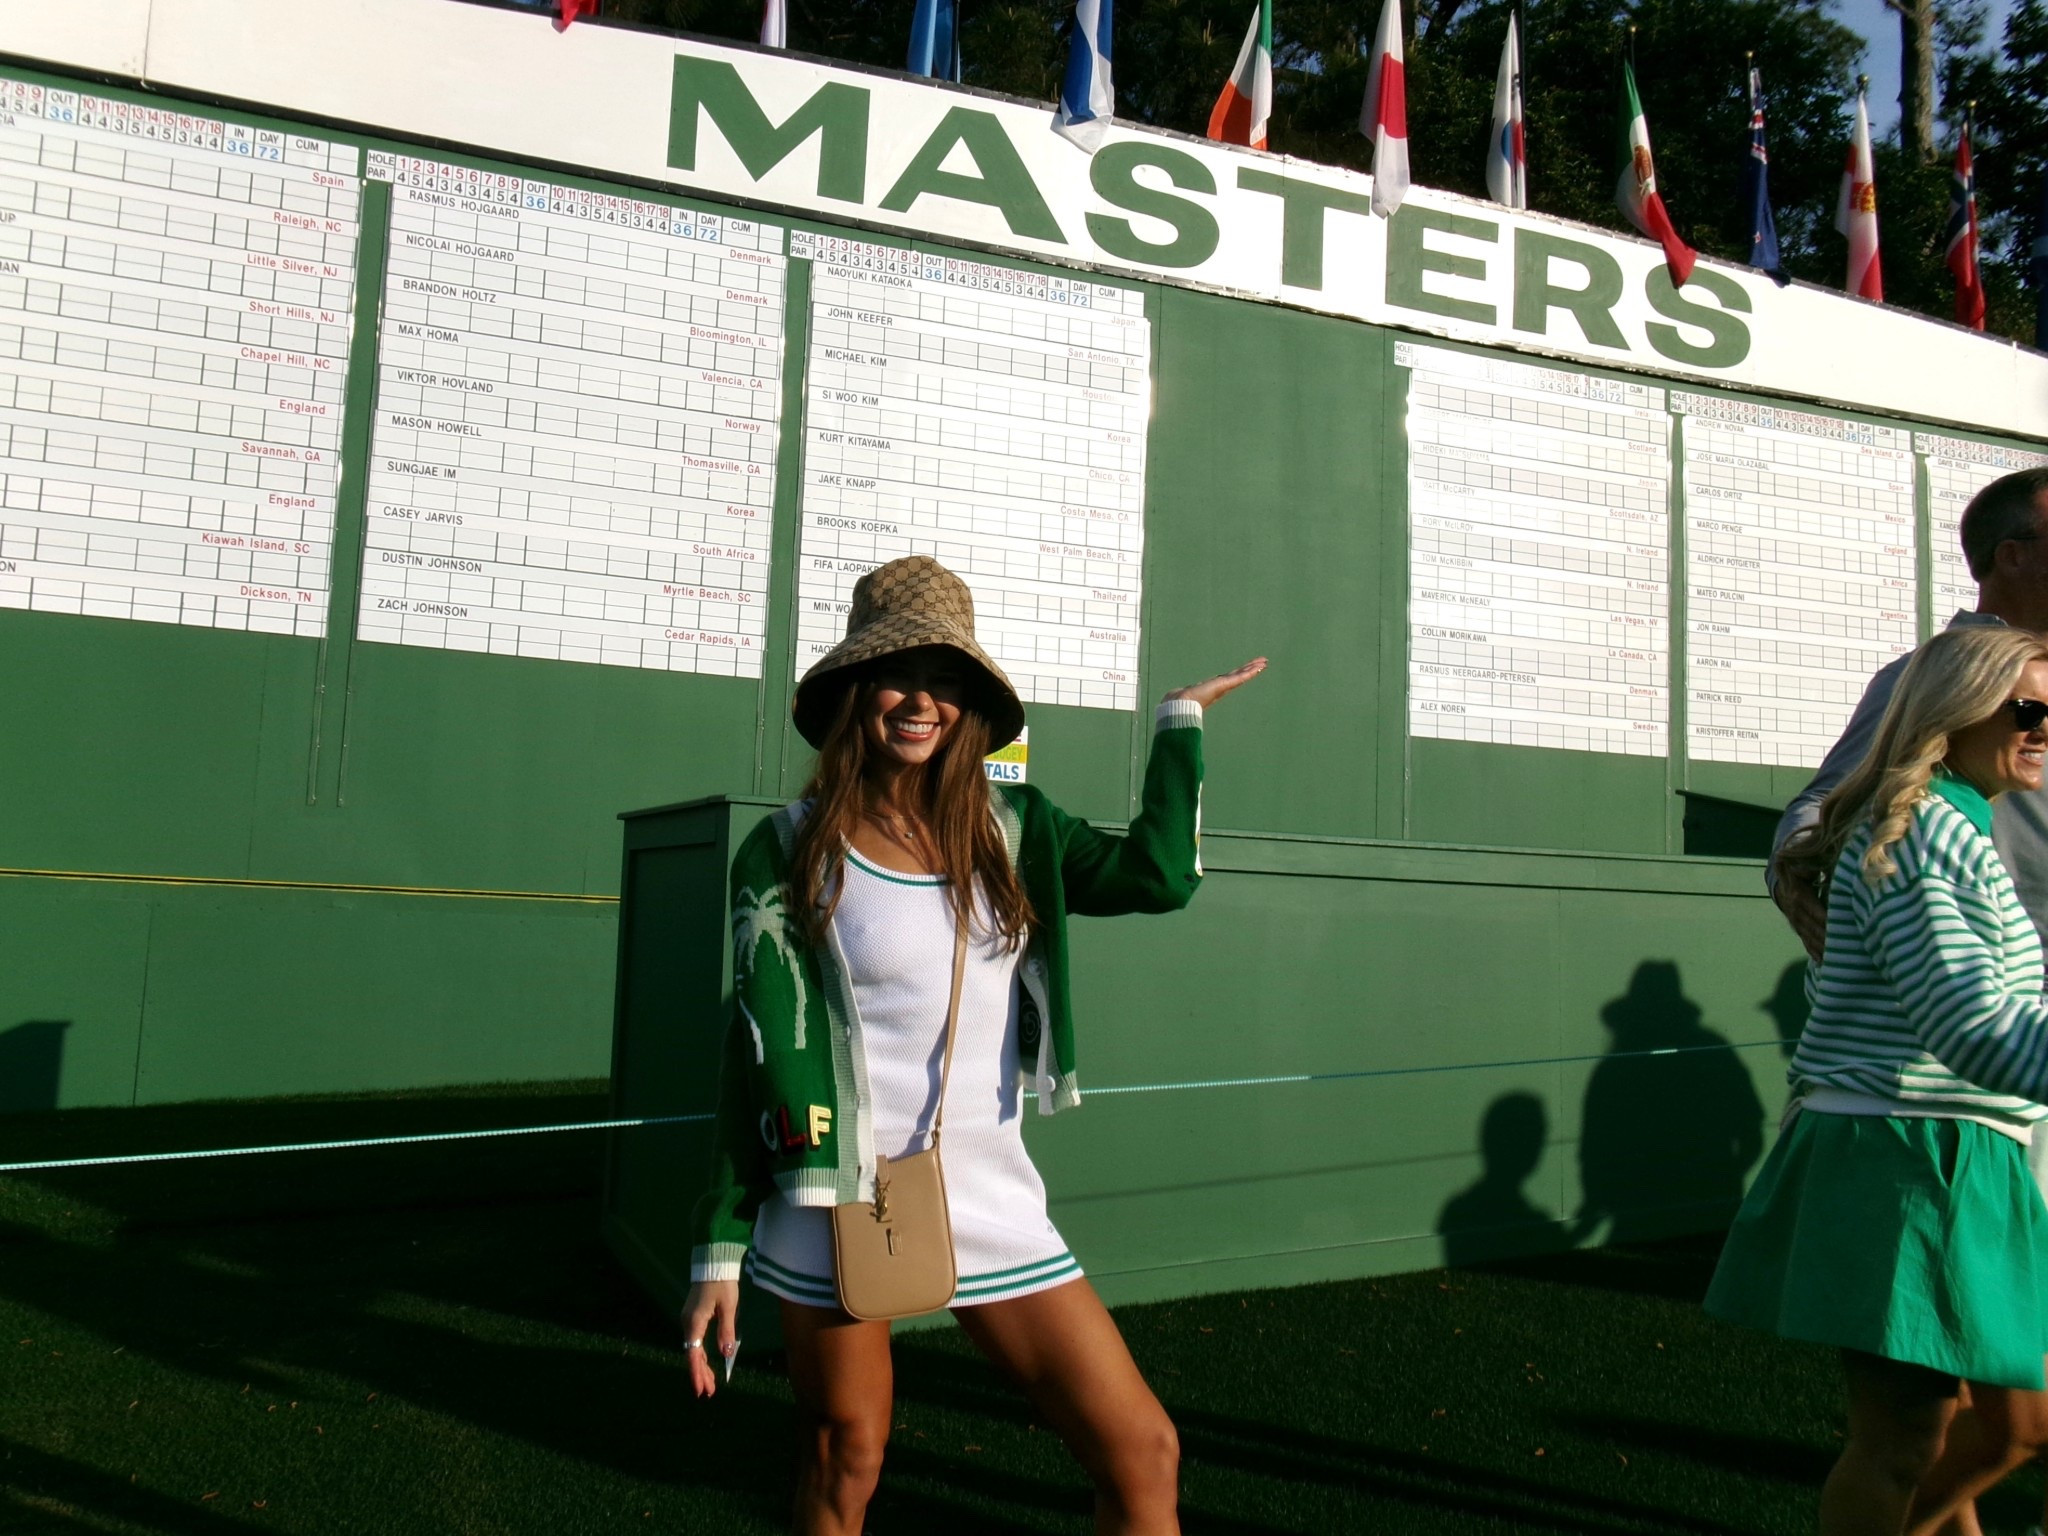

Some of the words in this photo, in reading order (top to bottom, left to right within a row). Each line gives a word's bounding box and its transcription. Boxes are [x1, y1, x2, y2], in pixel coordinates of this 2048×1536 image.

[51, 91, 74, 105] OUT
[235, 128, 244, 138] IN
[260, 133, 279, 144] DAY
[296, 140, 319, 152] CUM
[49, 108, 73, 121] 36
[227, 141, 249, 154] 36
[259, 146, 279, 160] 72
[312, 173, 344, 187] Spain
[369, 152, 395, 166] HOLE
[527, 183, 546, 194] OUT
[679, 212, 687, 221] IN
[701, 216, 717, 226] DAY
[731, 222, 750, 232] CUM
[368, 167, 386, 178] PAR
[526, 197, 546, 209] 36
[674, 224, 691, 235] 36
[700, 229, 717, 241] 72
[410, 191, 455, 207] RASMUS
[461, 202, 519, 218] HOJGAARD
[667, 54, 1752, 368] MASTERS
[274, 212, 319, 230] Raleigh,
[325, 220, 341, 232] NC
[406, 235, 450, 250] NICOLAI
[456, 245, 514, 261] HOJGAARD
[247, 254, 276, 268] Little
[283, 260, 317, 276] Silver,
[323, 265, 338, 277] NJ
[730, 250, 771, 264] Denmark
[792, 232, 814, 244] HOLE
[926, 257, 942, 266] OUT
[1055, 279, 1062, 288] IN
[1074, 282, 1087, 292] DAY
[1099, 288, 1115, 297] CUM
[792, 247, 807, 256] PAR
[925, 269, 942, 280] 36
[1051, 291, 1065, 302] 36
[1073, 295, 1087, 305] 72
[828, 267, 867, 281] NAOYUKI
[872, 273, 912, 288] KATAOKA
[404, 280, 457, 296] BRANDON
[462, 290, 496, 303] HOLTZ
[726, 291, 768, 305] Denmark
[249, 302, 280, 315] Short
[286, 307, 314, 321] Hills,
[319, 312, 334, 323] NJ
[828, 308, 852, 319] JOHN
[858, 312, 892, 326] KEEFER
[1111, 315, 1136, 326] Japan
[398, 325, 422, 337] MAX
[427, 330, 459, 343] HOMA
[690, 327, 754, 346] Bloomington,
[759, 338, 766, 346] IL
[241, 348, 281, 363] Chapel
[287, 353, 308, 367] Hill,
[314, 357, 330, 369] NC
[825, 349, 866, 363] MICHAEL
[871, 356, 887, 366] KIM
[398, 370, 436, 385] VIKTOR
[442, 378, 493, 393] HOVLAND
[702, 372, 745, 387] Valencia,
[750, 379, 762, 389] CA
[823, 391, 831, 399] SI
[836, 392, 858, 402] WOO
[862, 396, 878, 405] KIM
[280, 400, 326, 415] England
[392, 415, 431, 429] MASON
[438, 422, 482, 436] HOWELL
[726, 419, 760, 432] Norway
[819, 432, 844, 443] KURT
[848, 436, 891, 450] KITAYAMA
[1108, 433, 1131, 443] Korea
[242, 442, 298, 461] Savannah,
[305, 449, 320, 462] GA
[388, 461, 438, 477] SUNGJAE
[444, 469, 456, 478] IM
[682, 456, 742, 472] Thomasville,
[747, 465, 760, 474] GA
[819, 474, 841, 485] JAKE
[846, 478, 876, 489] KNAPP
[269, 494, 315, 508] England
[1696, 487, 1721, 497] CARLOS
[1724, 491, 1742, 500] ORTIZ
[384, 506, 420, 519] CASEY
[425, 512, 463, 525] JARVIS
[727, 506, 754, 517] Korea
[1061, 506, 1085, 517] Costa
[1118, 513, 1128, 521] CA
[817, 516, 856, 529] BROOKS
[861, 522, 898, 534] KOEPKA
[1697, 521, 1719, 530] MARCO
[1722, 524, 1742, 534] PENGE
[202, 533, 244, 547] Kiawah
[250, 538, 287, 552] Island,
[294, 542, 310, 553] SC
[693, 544, 721, 556] South
[726, 548, 755, 560] Africa
[1039, 544, 1059, 554] West
[1063, 546, 1082, 557] Palm
[1118, 553, 1127, 562] FL
[1422, 554, 1437, 562] TOM
[1440, 556, 1473, 567] McKIBBIN
[382, 553, 422, 566] DUSTIN
[428, 558, 482, 573] JOHNSON
[814, 559, 832, 570] FIFA
[240, 586, 291, 601] Dickson,
[298, 591, 311, 602] TN
[664, 585, 694, 597] Myrtle
[700, 589, 732, 601] Beach,
[738, 593, 751, 602] SC
[1093, 590, 1127, 602] Thailand
[1422, 591, 1456, 602] MAVERICK
[1460, 595, 1491, 606] McNEALY
[1697, 589, 1717, 598] MATEO
[1720, 592, 1744, 601] PULCINI
[378, 599, 408, 611] ZACH
[413, 603, 467, 617] JOHNSON
[814, 602, 831, 611] MIN
[836, 603, 850, 613] WO
[665, 629, 694, 641] Cedar
[700, 633, 736, 646] Rapids,
[742, 637, 750, 646] IA
[1090, 630, 1126, 642] Australia
[1422, 628, 1446, 637] COLLIN
[1450, 631, 1487, 642] MORIKAWA
[1712, 625, 1730, 633] RAHM
[1697, 658, 1718, 667] AARON
[1721, 660, 1731, 668] RAI
[1103, 671, 1125, 681] China
[1420, 665, 1449, 675] RASMUS
[1453, 668, 1536, 684] NEERGAARD-PETERSEN
[1630, 687, 1658, 696] Denmark
[1696, 693, 1721, 702] PATRICK
[1421, 702, 1437, 711] ALEX
[1441, 705, 1465, 713] NOREN
[1633, 722, 1658, 731] Sweden
[1696, 728, 1734, 737] KRISTOFFER
[1737, 731, 1759, 739] REITAN
